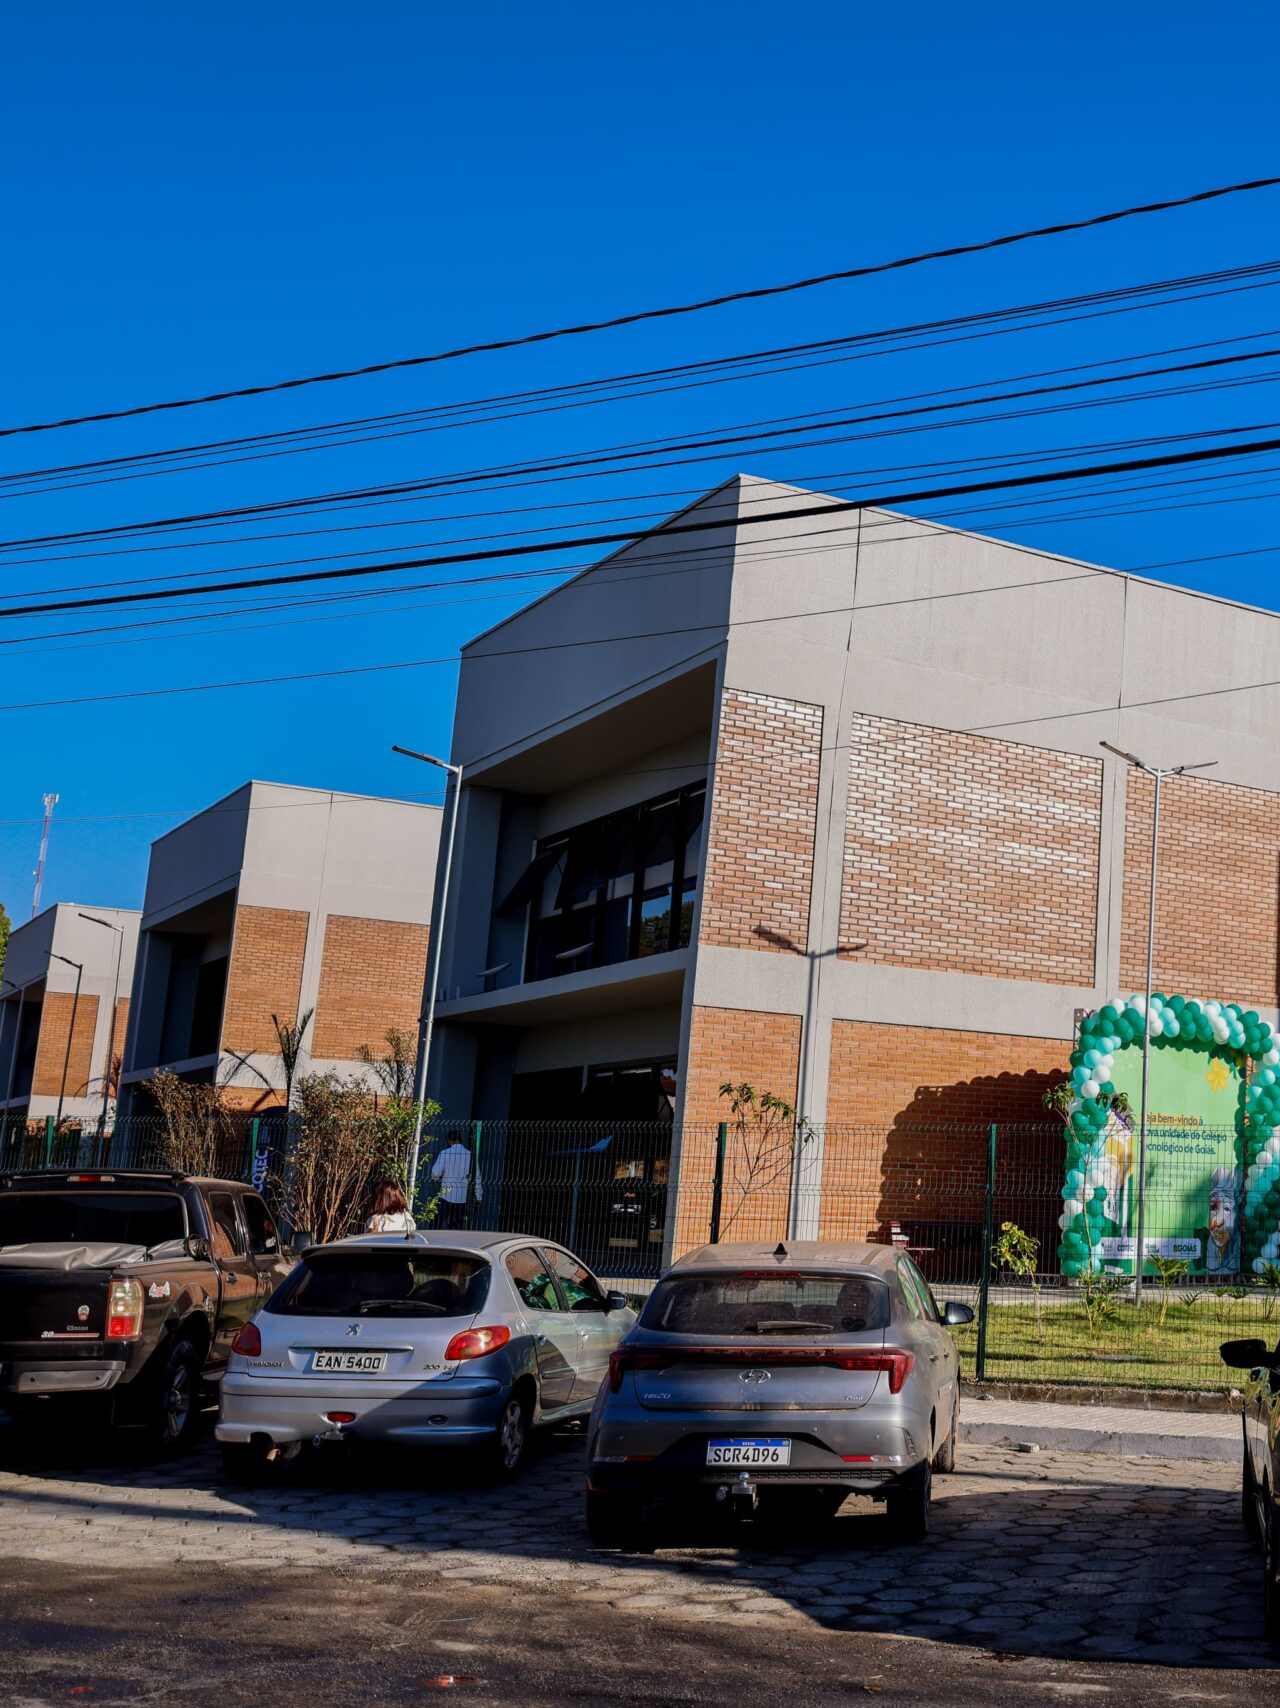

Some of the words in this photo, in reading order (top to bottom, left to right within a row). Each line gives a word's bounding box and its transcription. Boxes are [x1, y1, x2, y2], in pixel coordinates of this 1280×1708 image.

[1157, 1114, 1198, 1126] bem-vindo
[1160, 1128, 1190, 1139] unidade
[1191, 1131, 1200, 1140] do
[1184, 1144, 1194, 1154] de
[713, 1450, 780, 1463] SCR4D96
